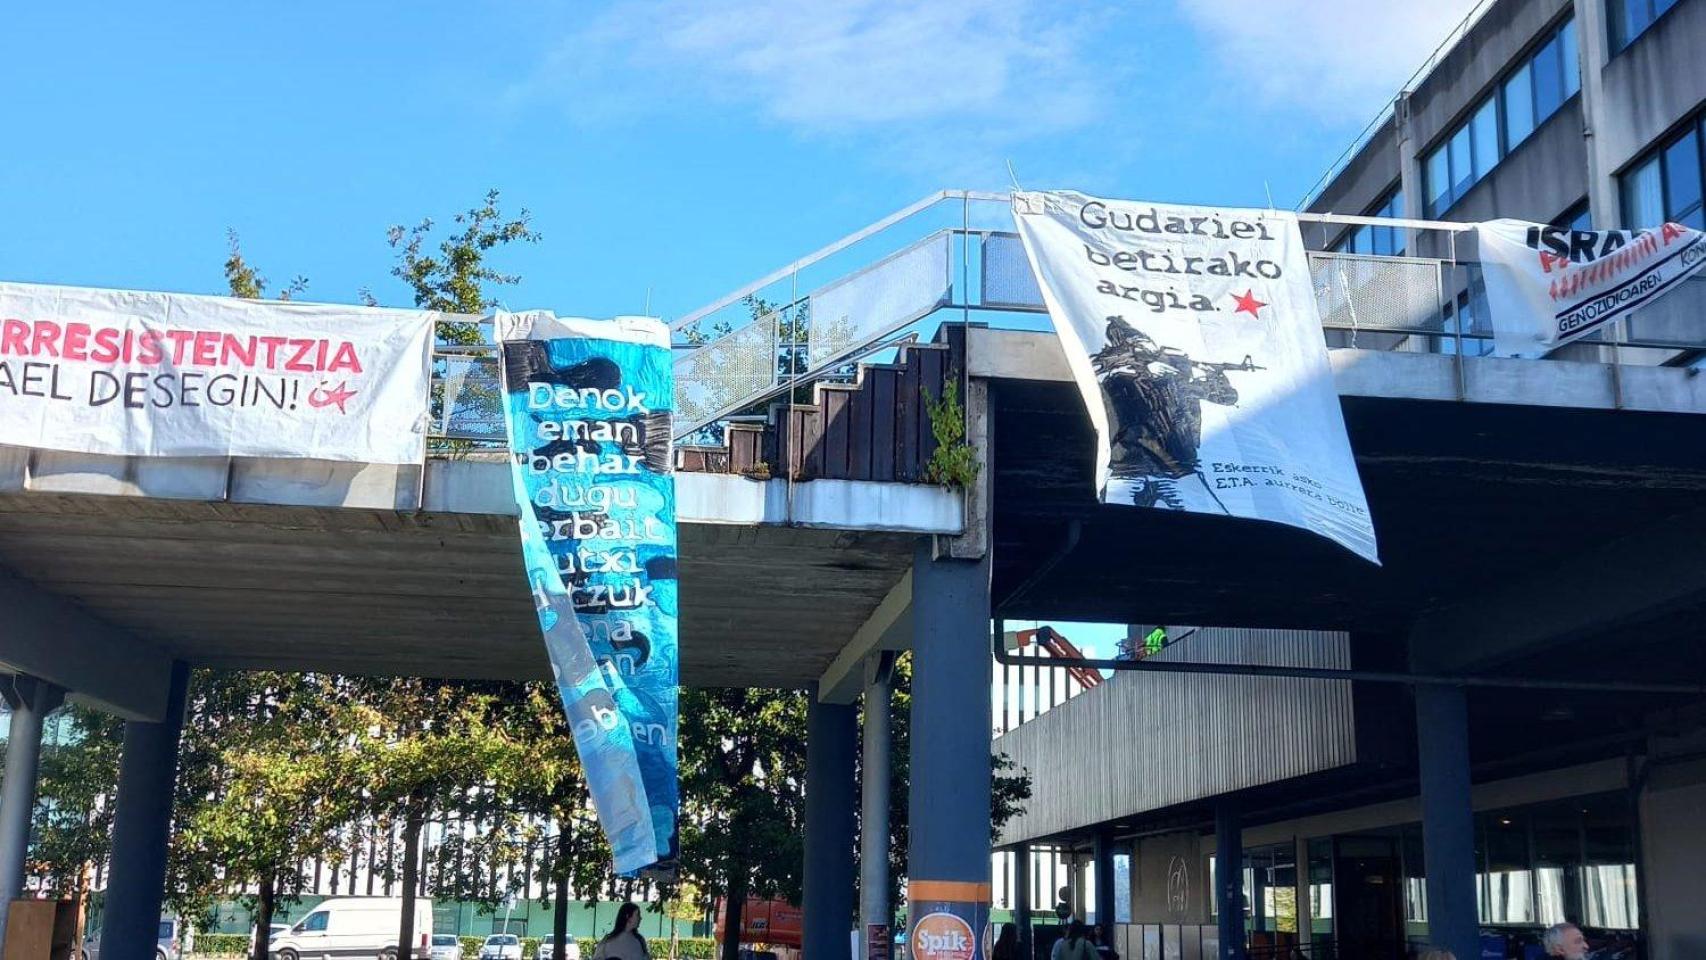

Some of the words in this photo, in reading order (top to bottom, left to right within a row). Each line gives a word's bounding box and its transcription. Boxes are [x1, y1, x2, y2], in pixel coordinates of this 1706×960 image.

[1080, 201, 1276, 241] Gudariei
[1085, 244, 1283, 280] betirako
[1096, 277, 1221, 313] argia.
[1559, 270, 1662, 332] GENOZIDIOAREN
[0, 318, 363, 373] RRESISTENTZIA
[88, 370, 299, 411] DESEGIN!
[528, 381, 650, 413] Denok
[537, 419, 638, 443] eman
[528, 445, 647, 474] behar
[1212, 461, 1285, 476] Eskerrik
[535, 478, 638, 515] dugu
[918, 928, 967, 955] Spik
